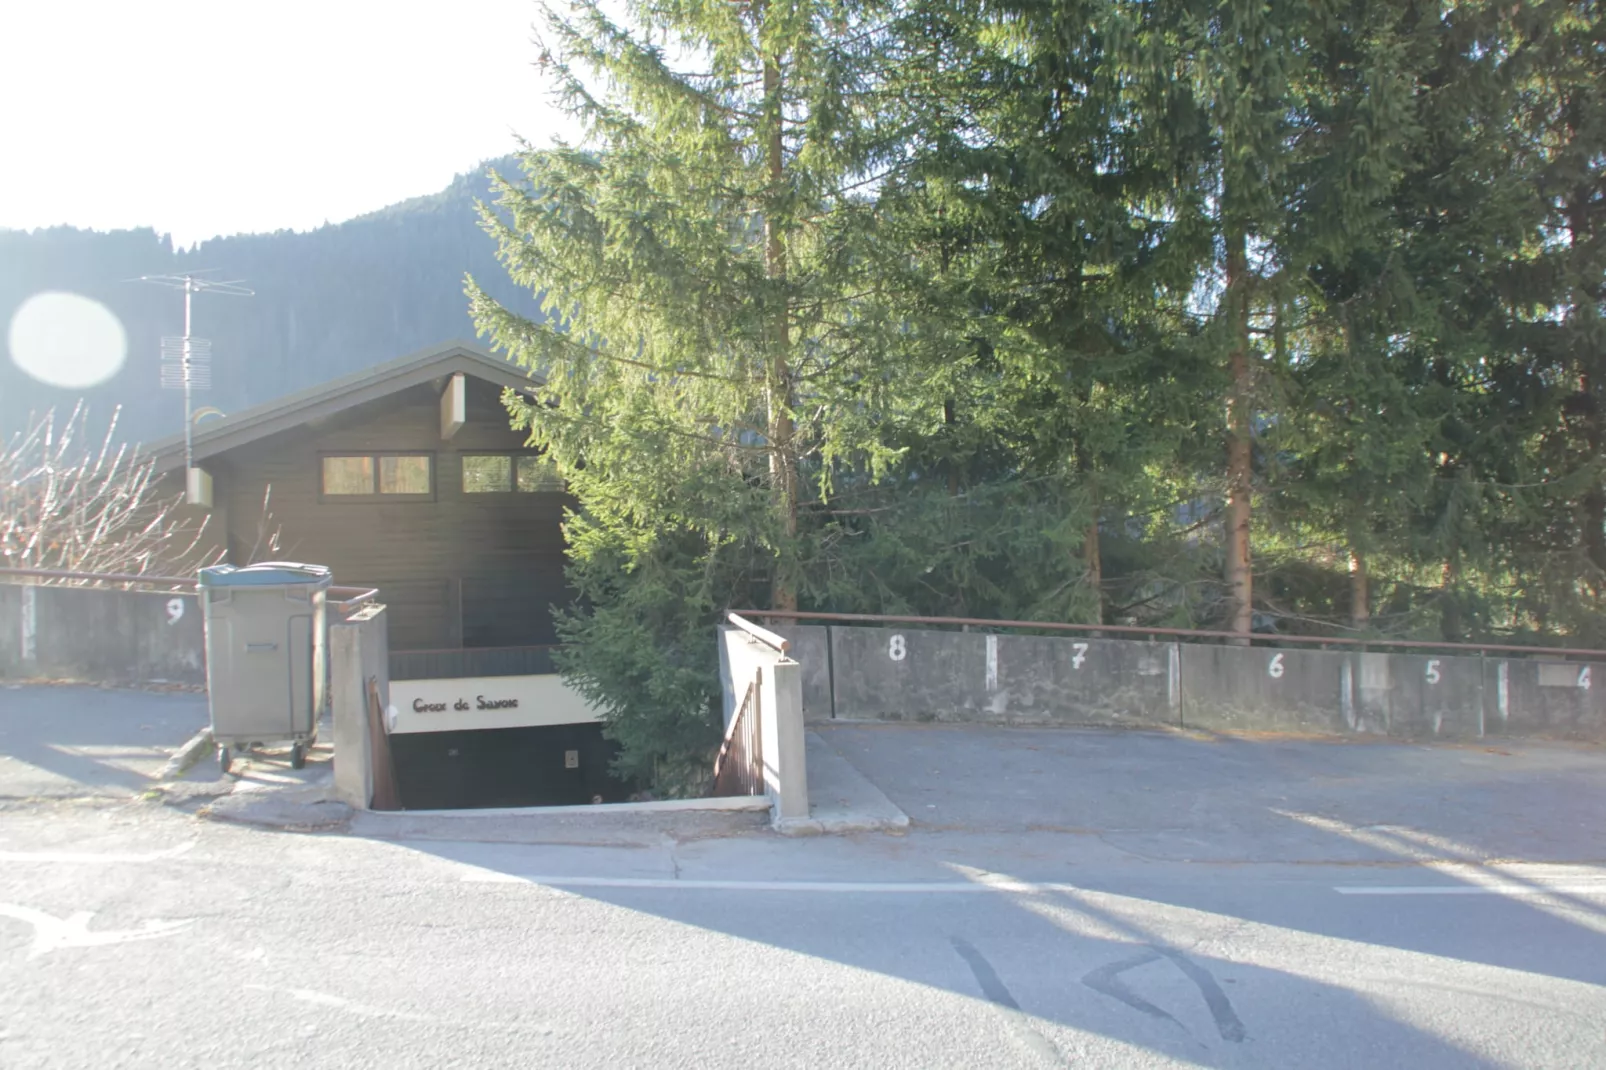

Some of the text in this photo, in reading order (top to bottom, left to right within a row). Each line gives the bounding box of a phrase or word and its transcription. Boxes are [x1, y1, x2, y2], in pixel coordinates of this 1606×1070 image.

[167, 598, 185, 625] 9
[888, 634, 907, 661] 8
[1073, 643, 1088, 669] 7
[1269, 653, 1284, 678] 6
[1426, 659, 1441, 685] 5
[1577, 667, 1591, 690] 4
[453, 698, 470, 711] de
